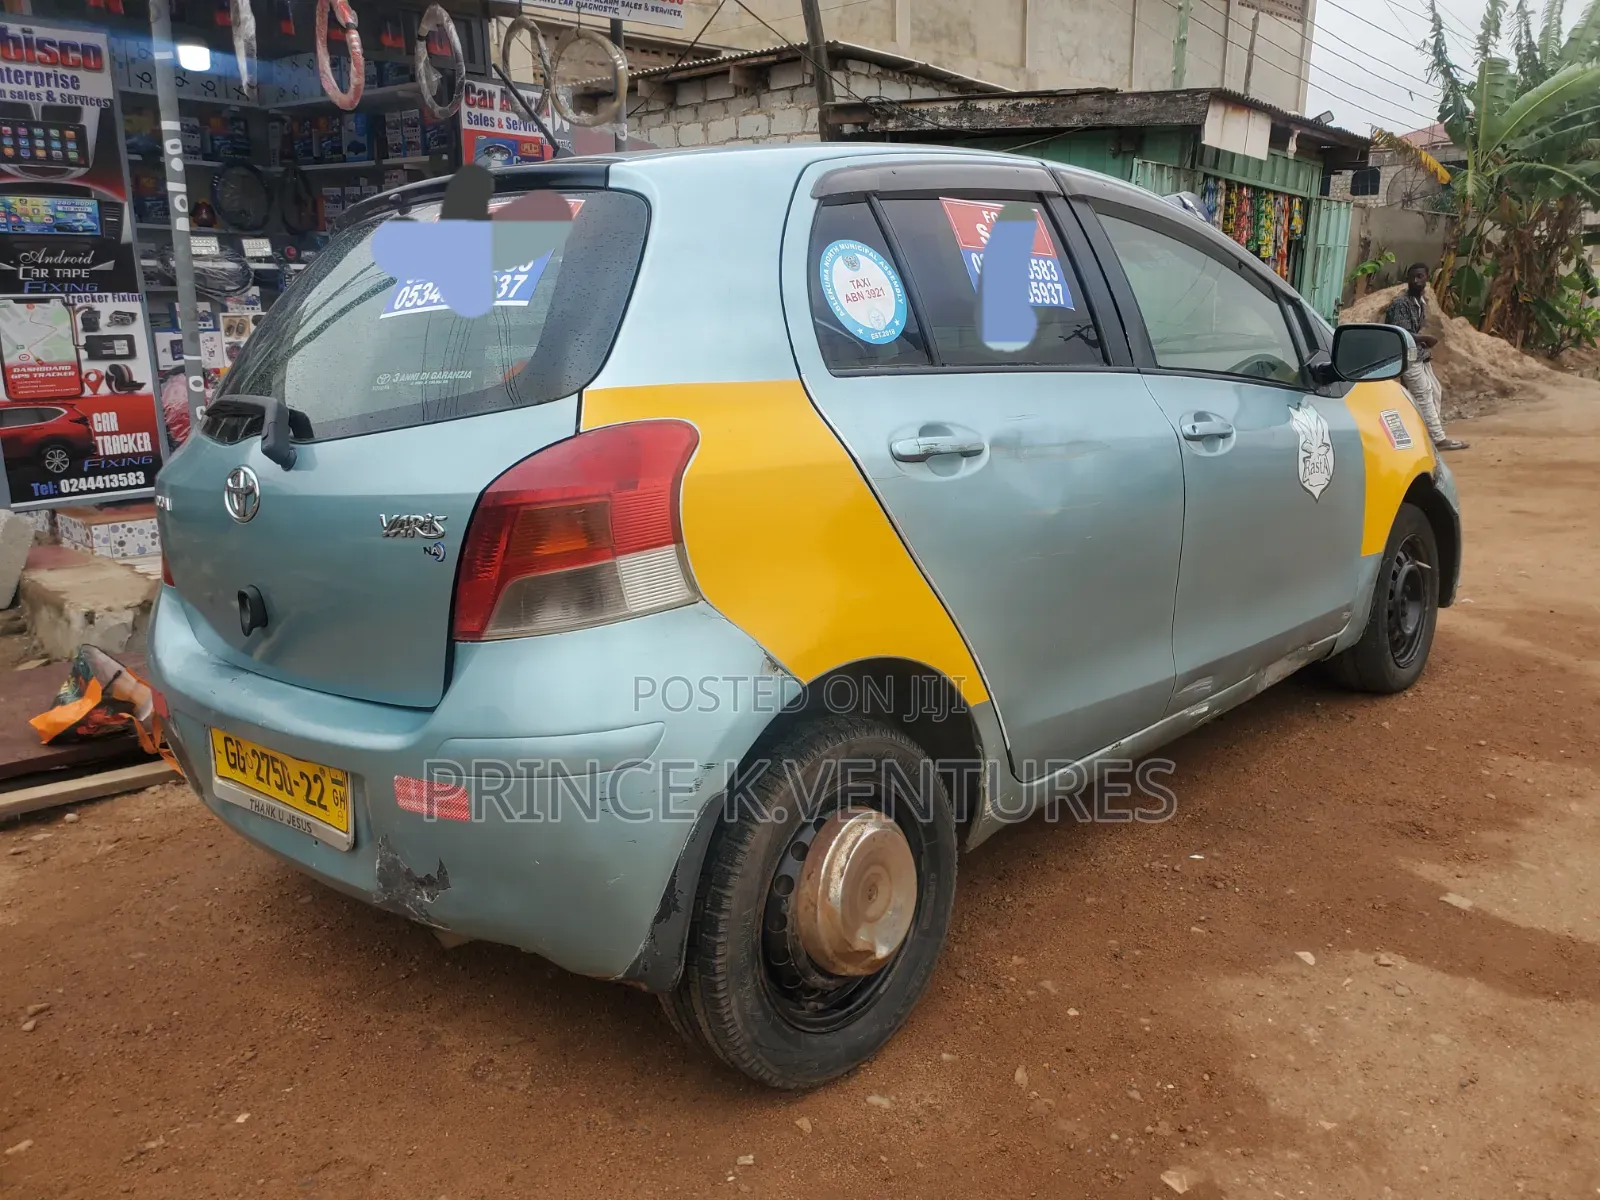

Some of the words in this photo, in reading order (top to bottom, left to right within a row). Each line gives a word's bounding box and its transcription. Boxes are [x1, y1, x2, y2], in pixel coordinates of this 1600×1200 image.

[620, 1, 642, 10] SALES
[643, 3, 649, 11] &
[10, 90, 42, 101] sales
[46, 90, 56, 102] &
[60, 92, 110, 108] services
[464, 80, 496, 111] Car
[467, 111, 495, 128] Sales
[497, 117, 504, 129] &
[20, 247, 95, 265] Android
[19, 264, 49, 281] CAR
[55, 268, 91, 278] TAPE
[823, 245, 840, 268] NORTH
[838, 243, 878, 261] MUNICIPAL
[879, 260, 904, 305] ASSEMBLY
[24, 281, 98, 294] FIXING
[849, 277, 872, 290] TAXI
[64, 293, 108, 304] Tracker
[845, 291, 865, 304] ABN
[865, 286, 886, 300] 3921
[393, 372, 400, 383] 3
[400, 372, 421, 382] ANNI
[421, 372, 431, 380] DI
[431, 370, 473, 380] GARANZIA
[92, 411, 119, 433] CAR
[95, 432, 152, 456] TRACKER
[83, 456, 153, 472] FIXING
[31, 481, 58, 497] Tel:
[60, 471, 146, 493] 0244413583
[332, 788, 346, 811] GH
[250, 799, 276, 819] THANK
[278, 809, 285, 822] U
[286, 812, 313, 834] JESUS
